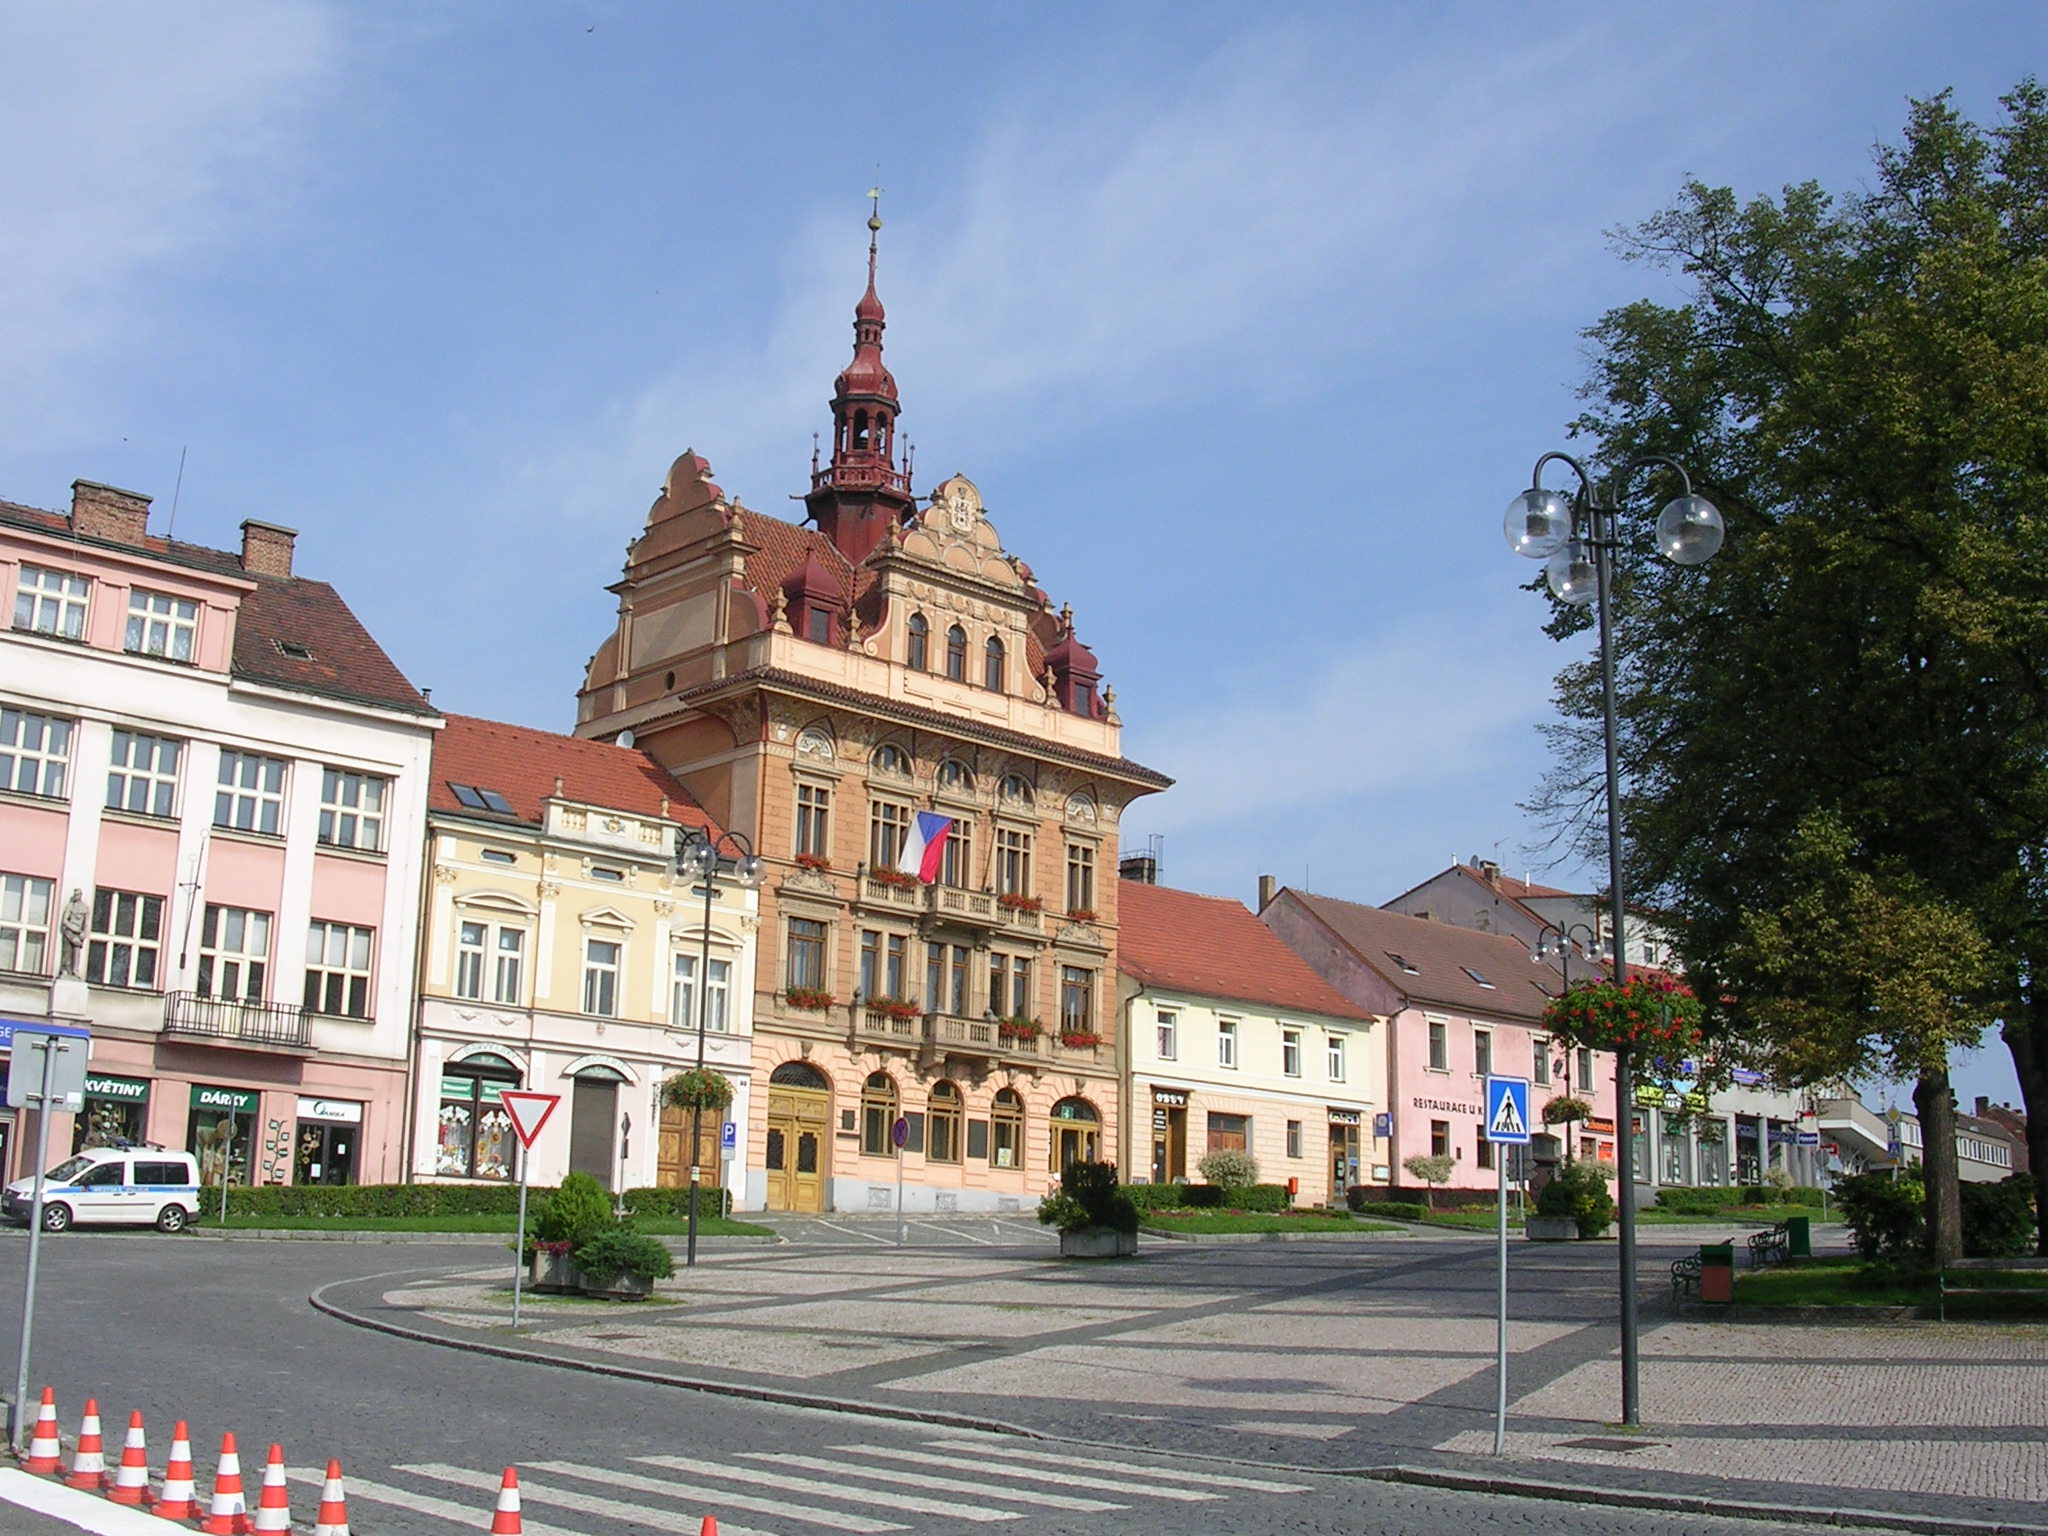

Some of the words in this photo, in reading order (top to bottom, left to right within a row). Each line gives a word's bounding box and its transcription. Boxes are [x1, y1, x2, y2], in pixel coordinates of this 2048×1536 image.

[84, 1079, 145, 1097] KVĚTINY
[200, 1091, 249, 1107] DÁRKY
[1413, 1097, 1467, 1114] RESTAURACE
[1469, 1105, 1475, 1115] U
